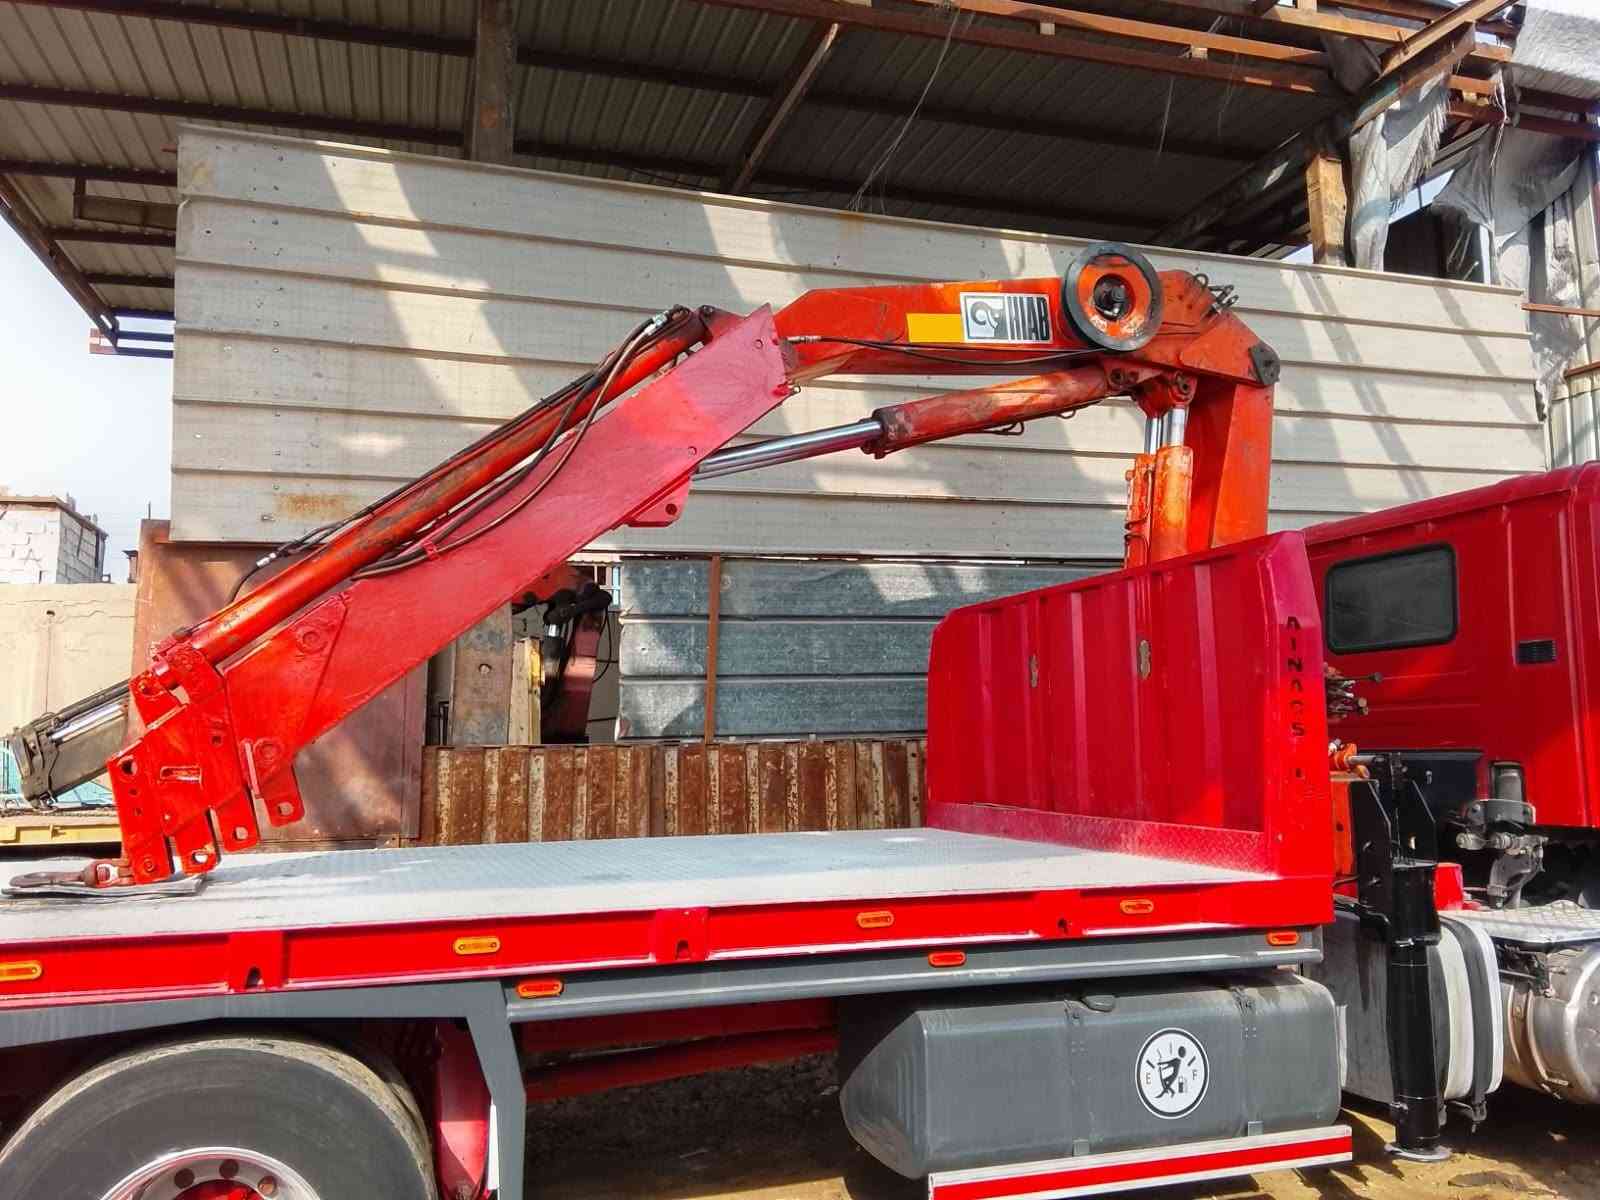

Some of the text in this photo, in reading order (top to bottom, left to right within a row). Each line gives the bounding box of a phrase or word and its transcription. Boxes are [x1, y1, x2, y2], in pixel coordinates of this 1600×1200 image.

[1006, 295, 1051, 341] HIAB
[1145, 1072, 1152, 1085] E
[1192, 1069, 1199, 1081] F
